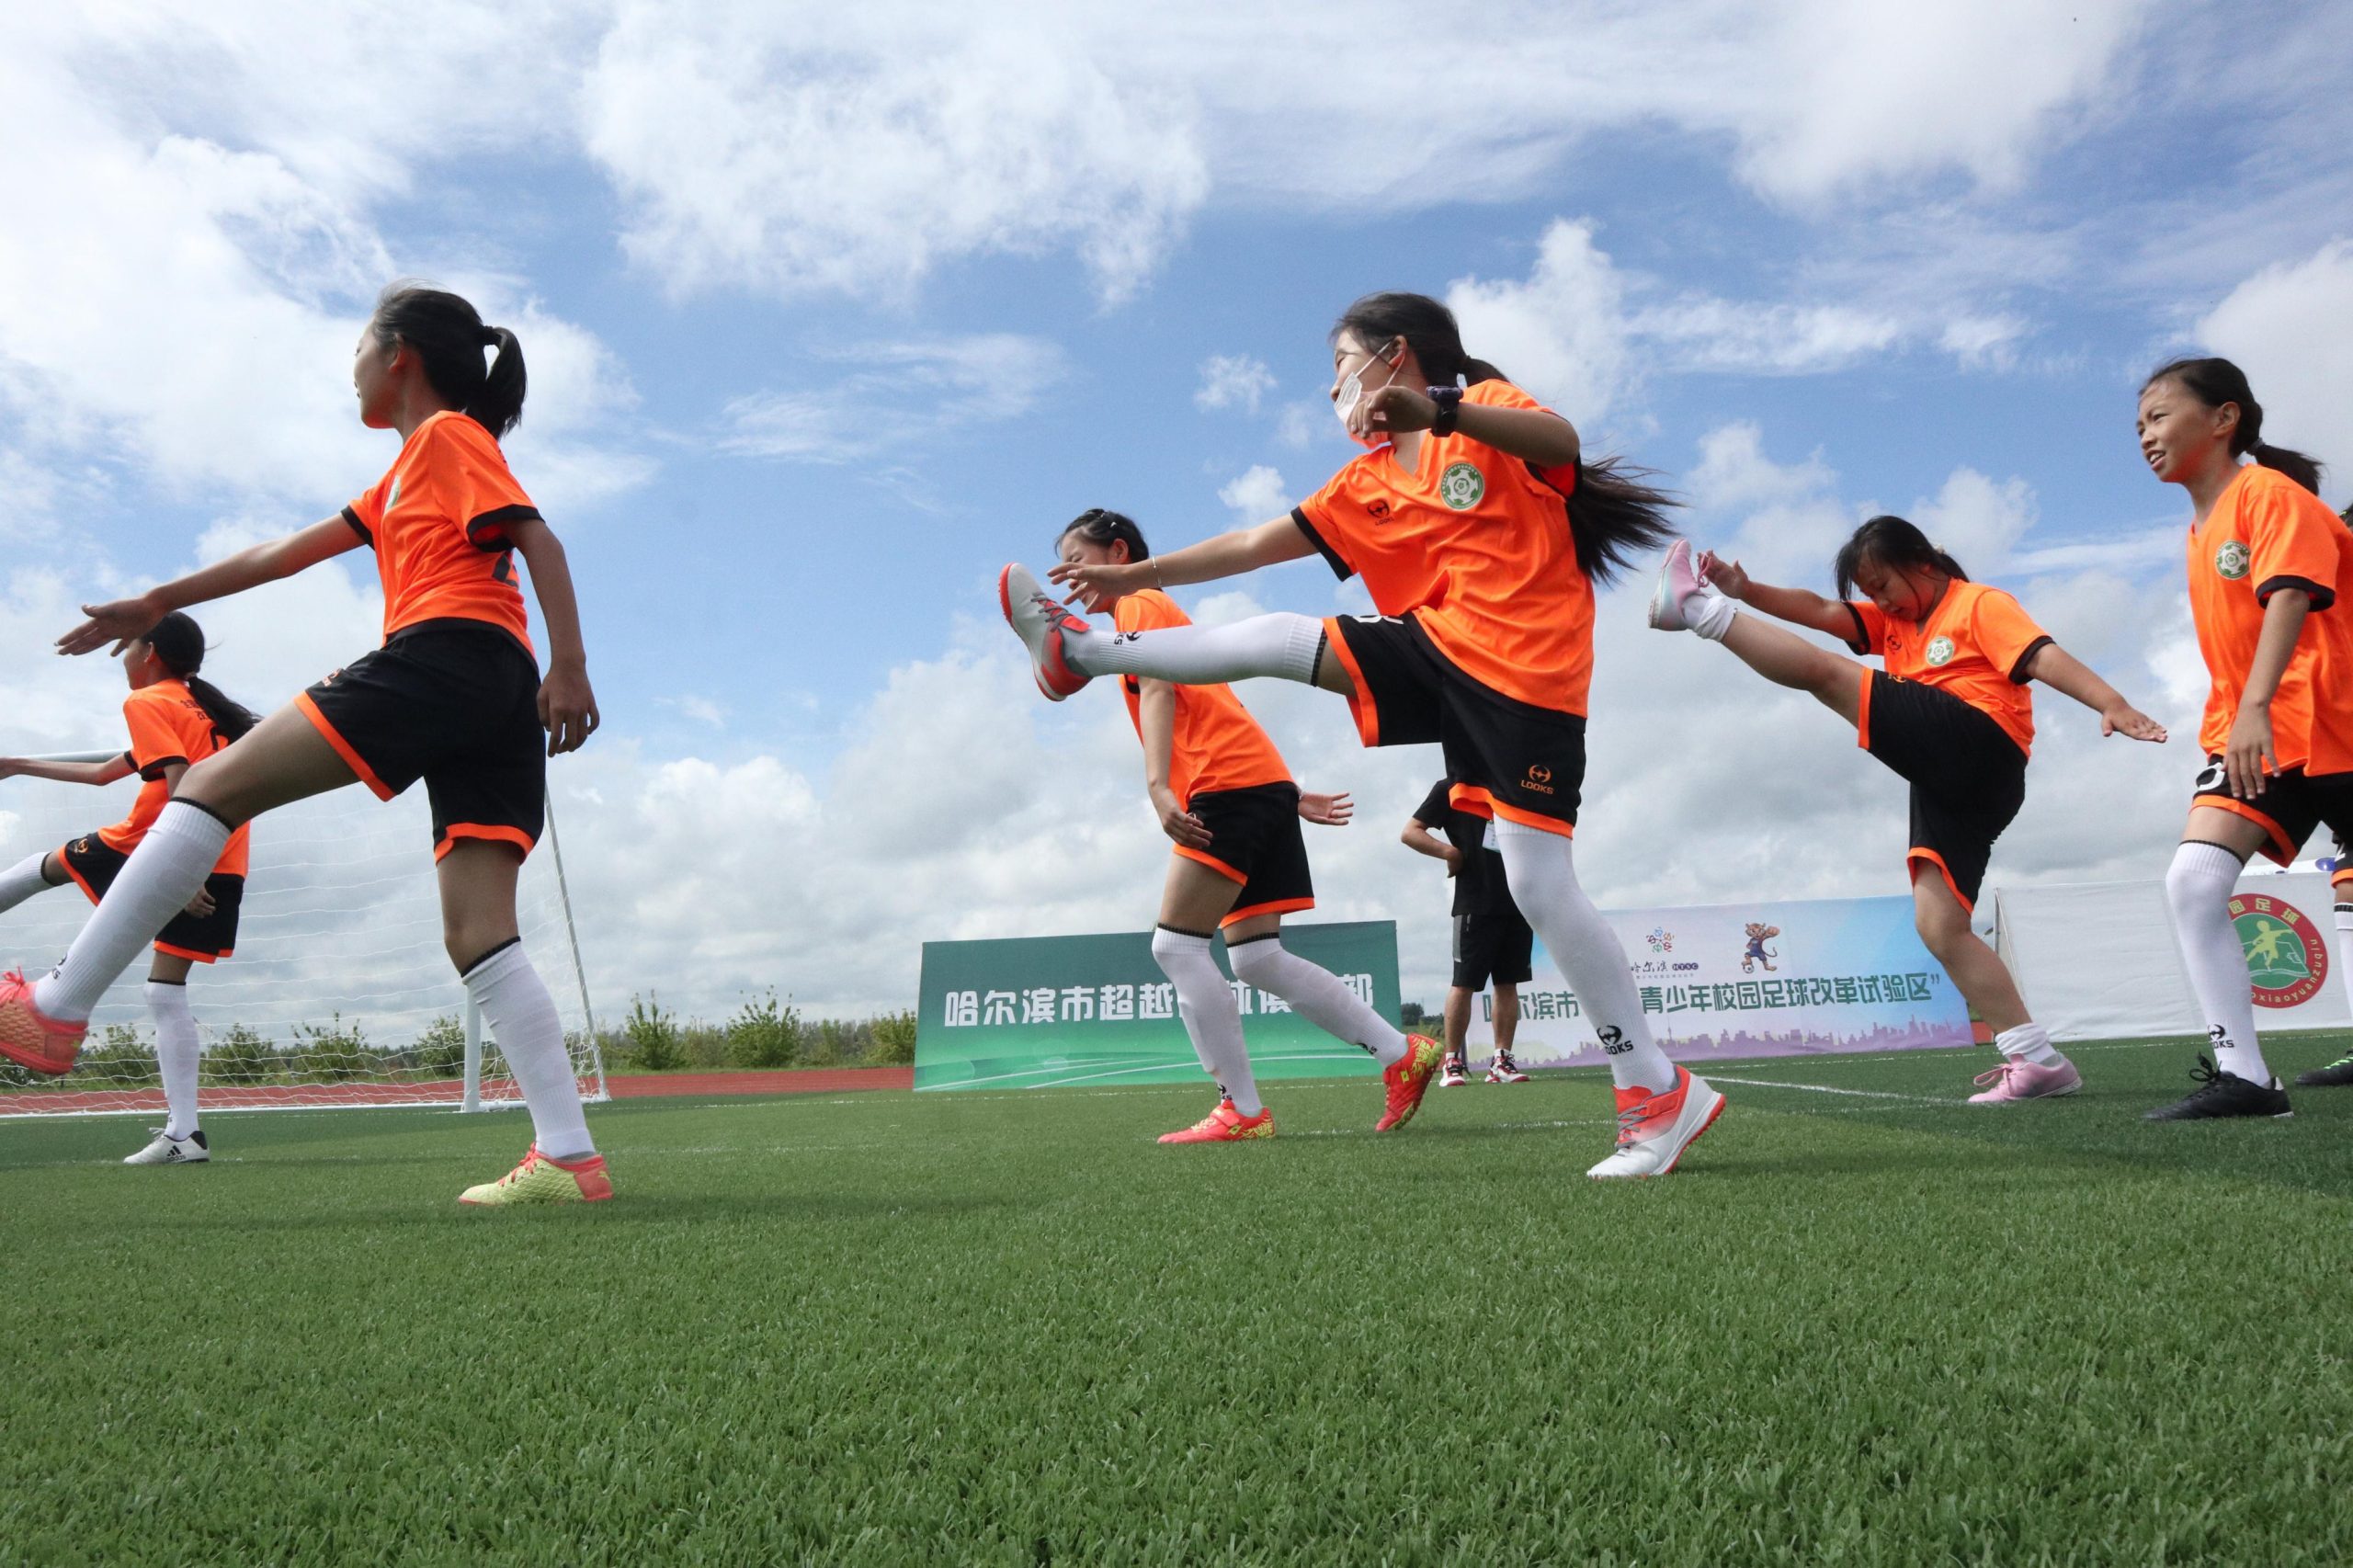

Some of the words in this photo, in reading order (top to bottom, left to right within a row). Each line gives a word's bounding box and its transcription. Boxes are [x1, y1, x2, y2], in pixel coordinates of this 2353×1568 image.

[1520, 779, 1554, 795] LOOKS
[2228, 898, 2300, 925] 园足球
[1605, 1040, 1634, 1055] OOKS
